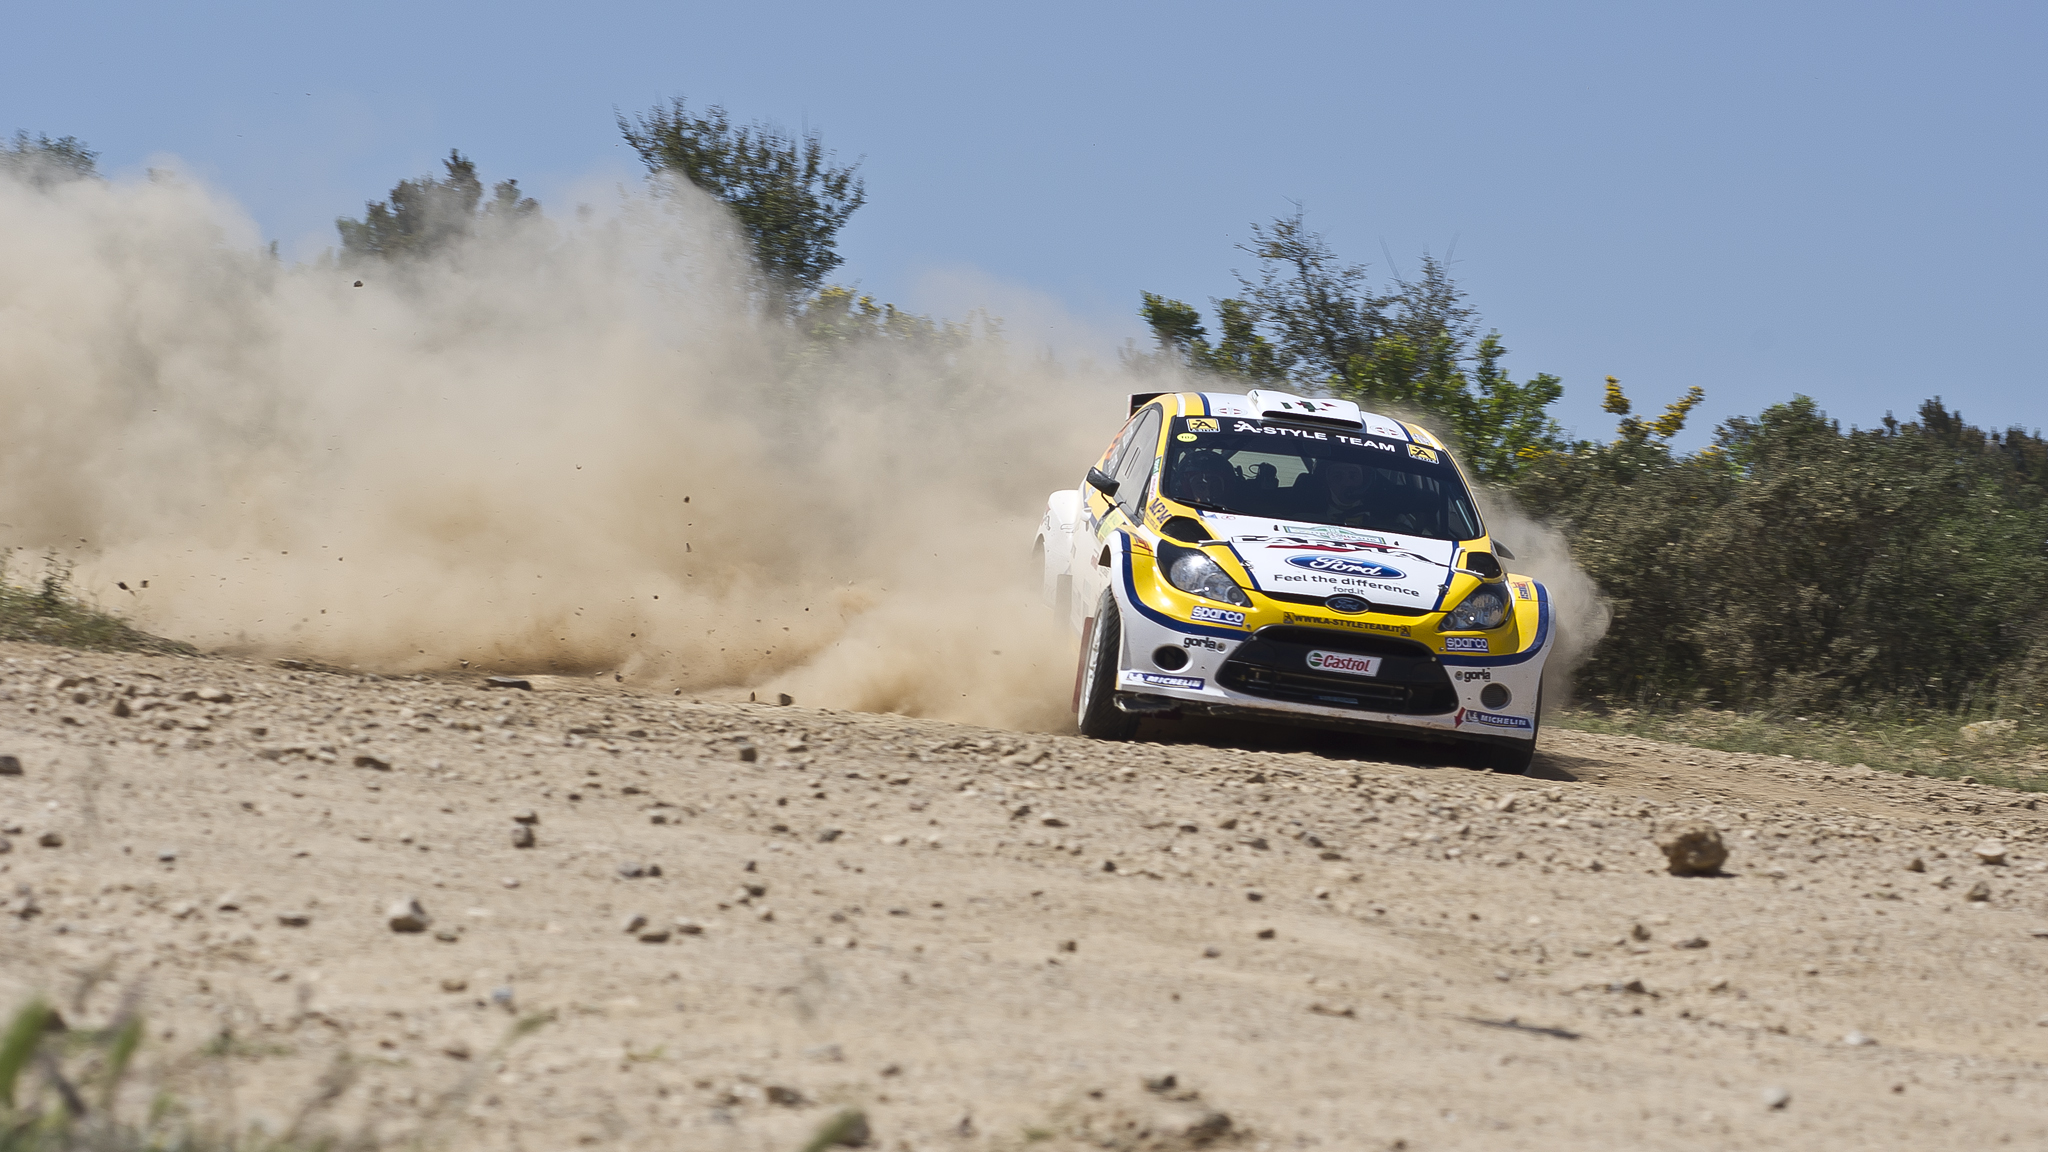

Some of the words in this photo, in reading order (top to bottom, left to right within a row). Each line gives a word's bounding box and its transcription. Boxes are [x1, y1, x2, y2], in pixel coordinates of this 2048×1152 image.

[1335, 435, 1396, 452] TEAM
[1309, 556, 1382, 577] Ford
[1274, 574, 1308, 582] Feel
[1311, 575, 1337, 584] the
[1341, 578, 1420, 597] difference
[1333, 586, 1365, 595] ford.it
[1192, 606, 1244, 622] sparco
[1446, 638, 1487, 650] sparco
[1323, 655, 1371, 671] Castrol
[1146, 676, 1203, 688] MICHELIN
[1480, 714, 1526, 726] MICHELIN
